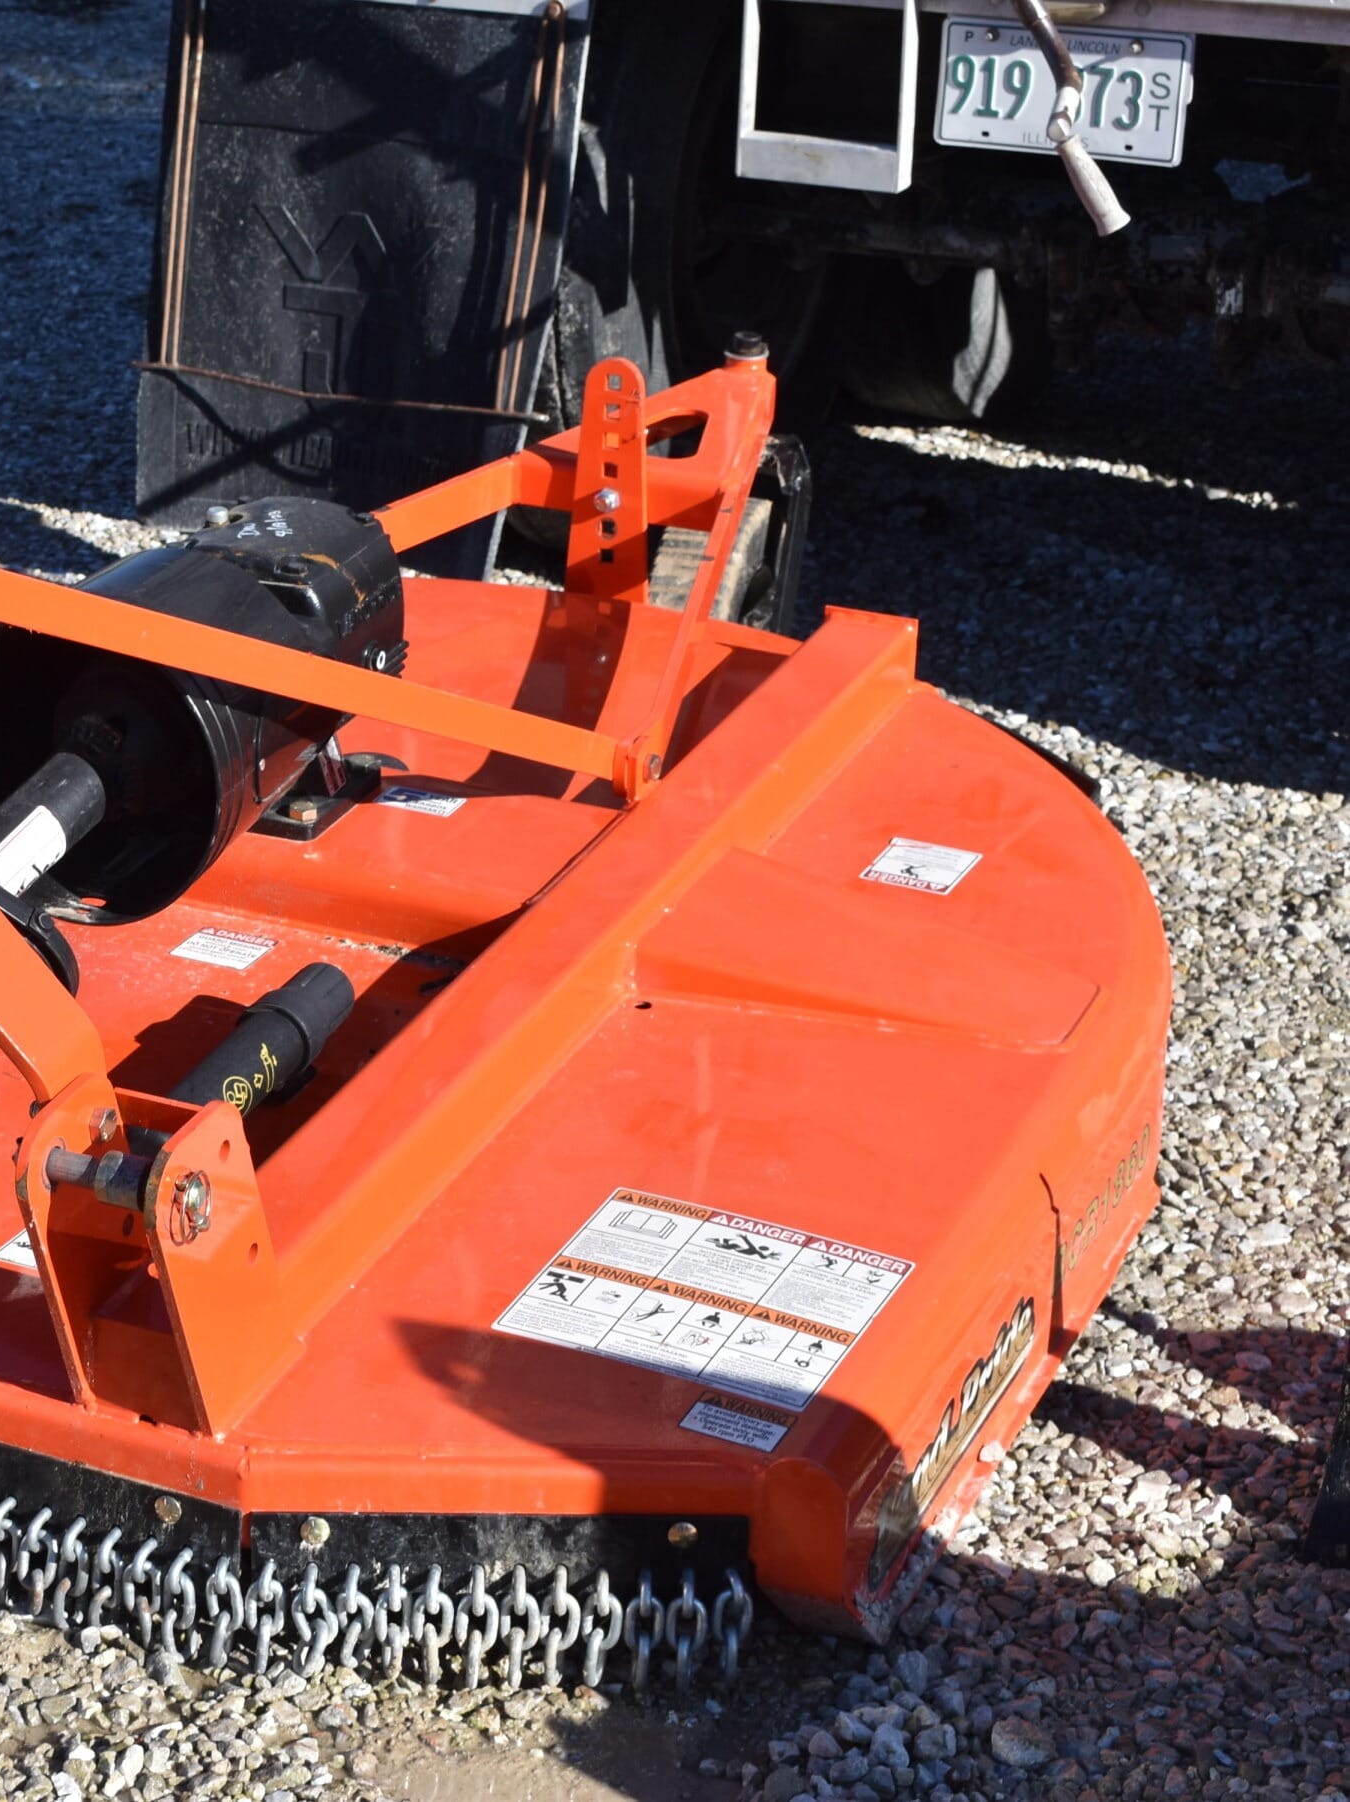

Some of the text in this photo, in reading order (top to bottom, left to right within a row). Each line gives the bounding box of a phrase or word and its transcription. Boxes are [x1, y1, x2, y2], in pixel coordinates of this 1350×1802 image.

[1067, 40, 1122, 55] LINCOLN
[948, 54, 1033, 120] 919
[1021, 131, 1090, 150] ILLIS
[867, 869, 929, 889] DANGER
[215, 929, 276, 947] DANGER
[636, 1195, 708, 1220] WARNING
[729, 1217, 807, 1246] DANGER
[828, 1243, 907, 1273] DANGER
[575, 1261, 649, 1287] WARNING
[672, 1284, 748, 1312] WARNING
[774, 1313, 851, 1343] WARNING
[727, 1399, 790, 1426] WARNING
